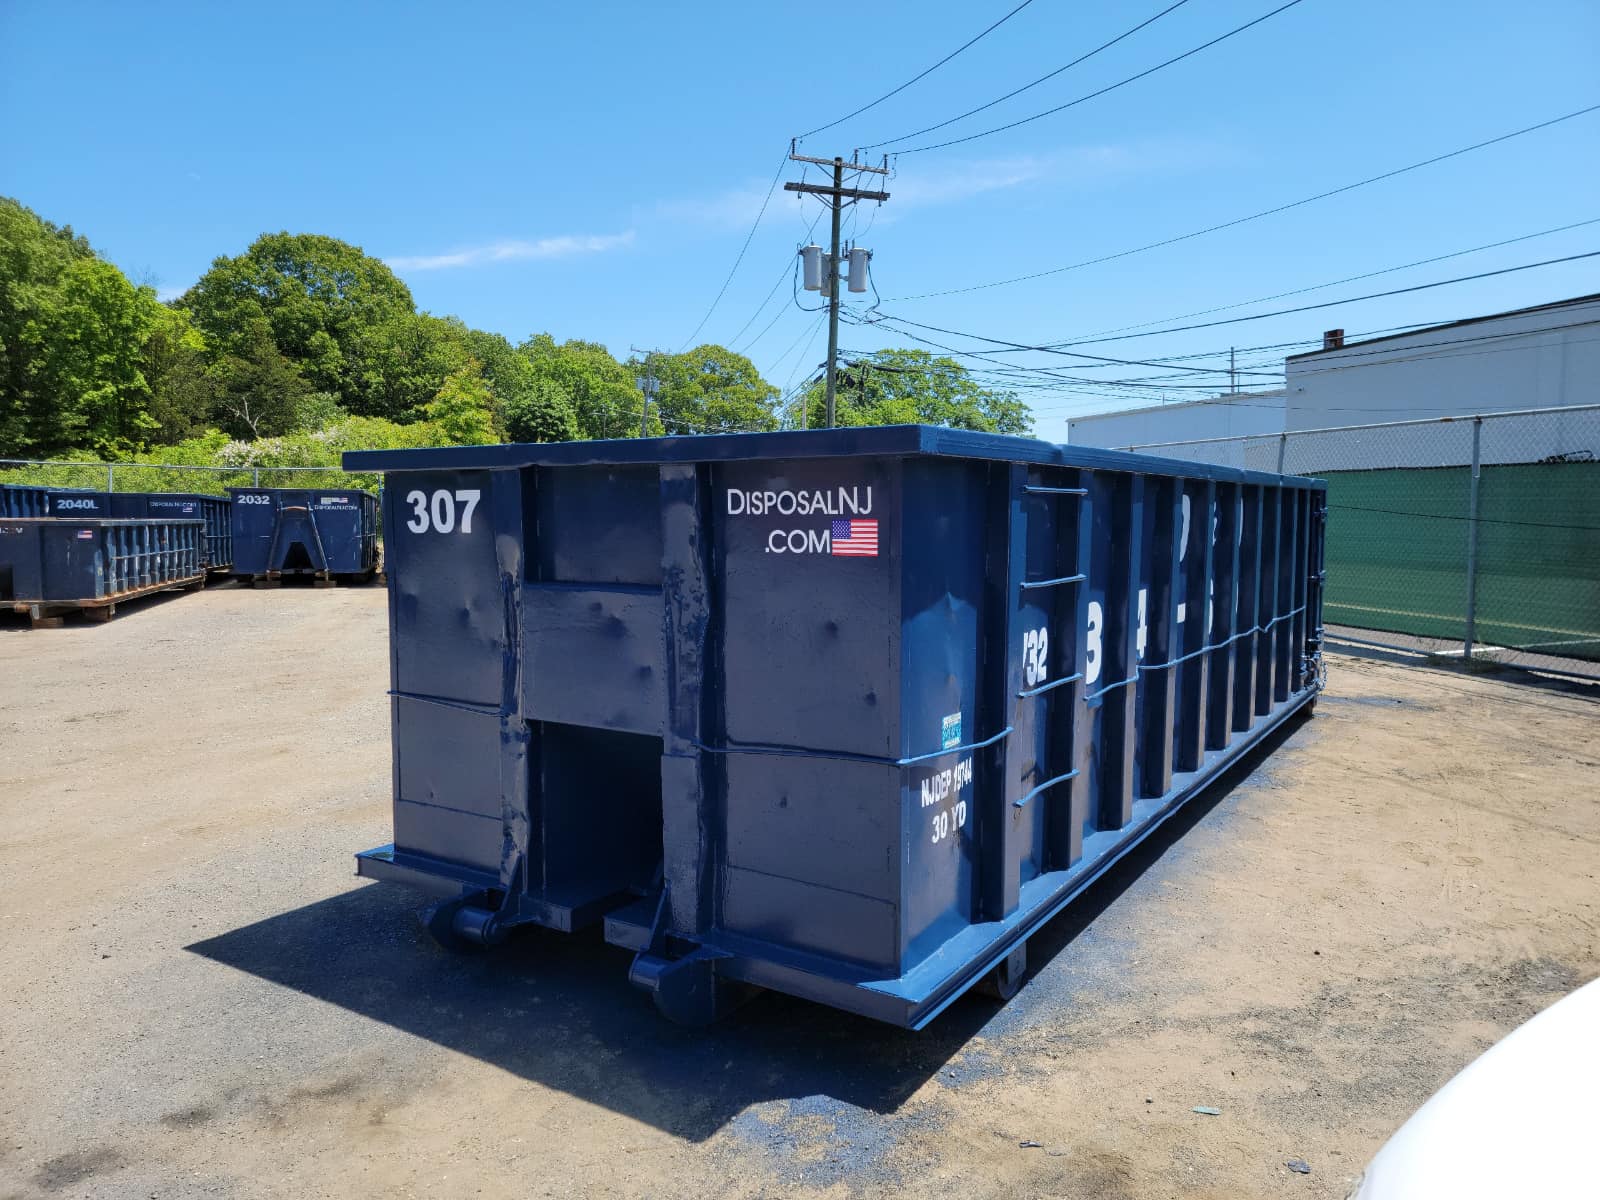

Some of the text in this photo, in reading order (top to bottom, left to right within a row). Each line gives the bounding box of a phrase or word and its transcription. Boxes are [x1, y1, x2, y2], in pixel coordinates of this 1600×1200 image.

[56, 499, 99, 509] 2040L
[238, 495, 270, 504] 2032
[406, 489, 481, 534] 307
[727, 486, 873, 516] DISPOSALNJ
[764, 529, 831, 555] .COM
[921, 768, 952, 808] NJDEP
[932, 800, 967, 844] 30 YD
